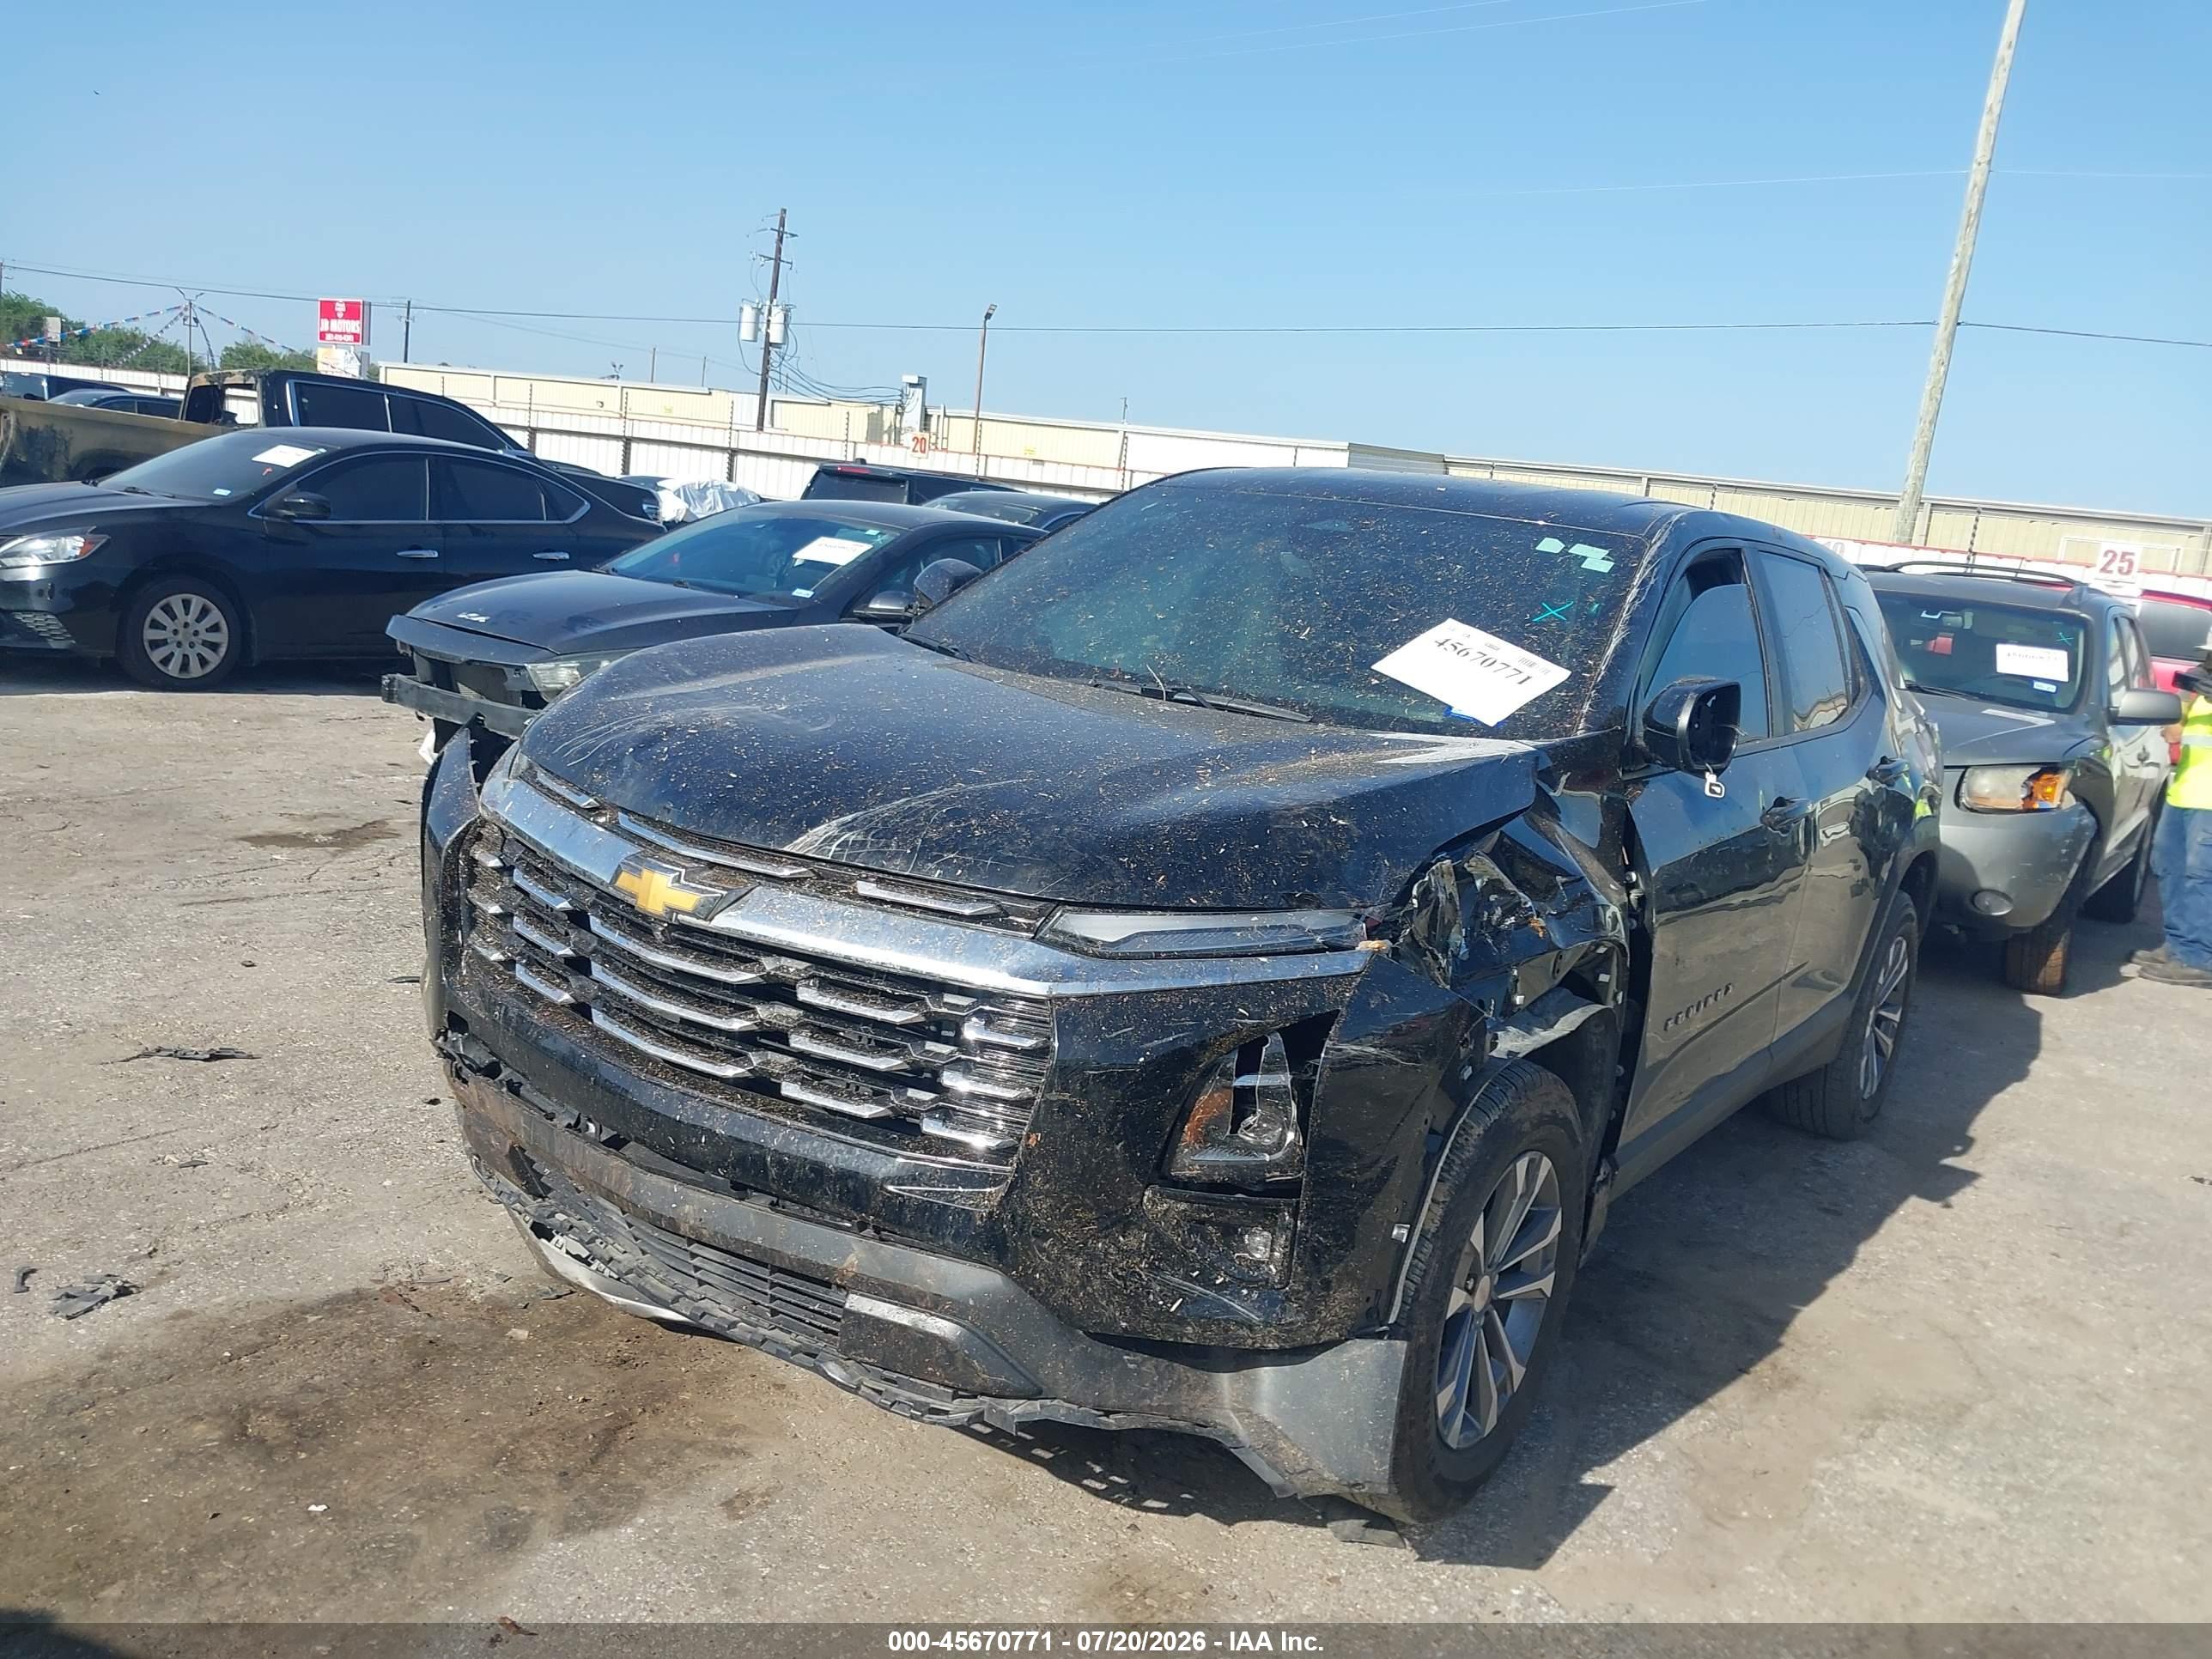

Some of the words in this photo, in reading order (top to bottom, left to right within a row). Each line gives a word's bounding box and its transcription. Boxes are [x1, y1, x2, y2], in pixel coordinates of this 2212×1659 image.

[330, 318, 361, 335] MOTORS
[912, 436, 927, 453] 20
[2099, 549, 2136, 576] 25
[1434, 637, 1533, 685] 45670771
